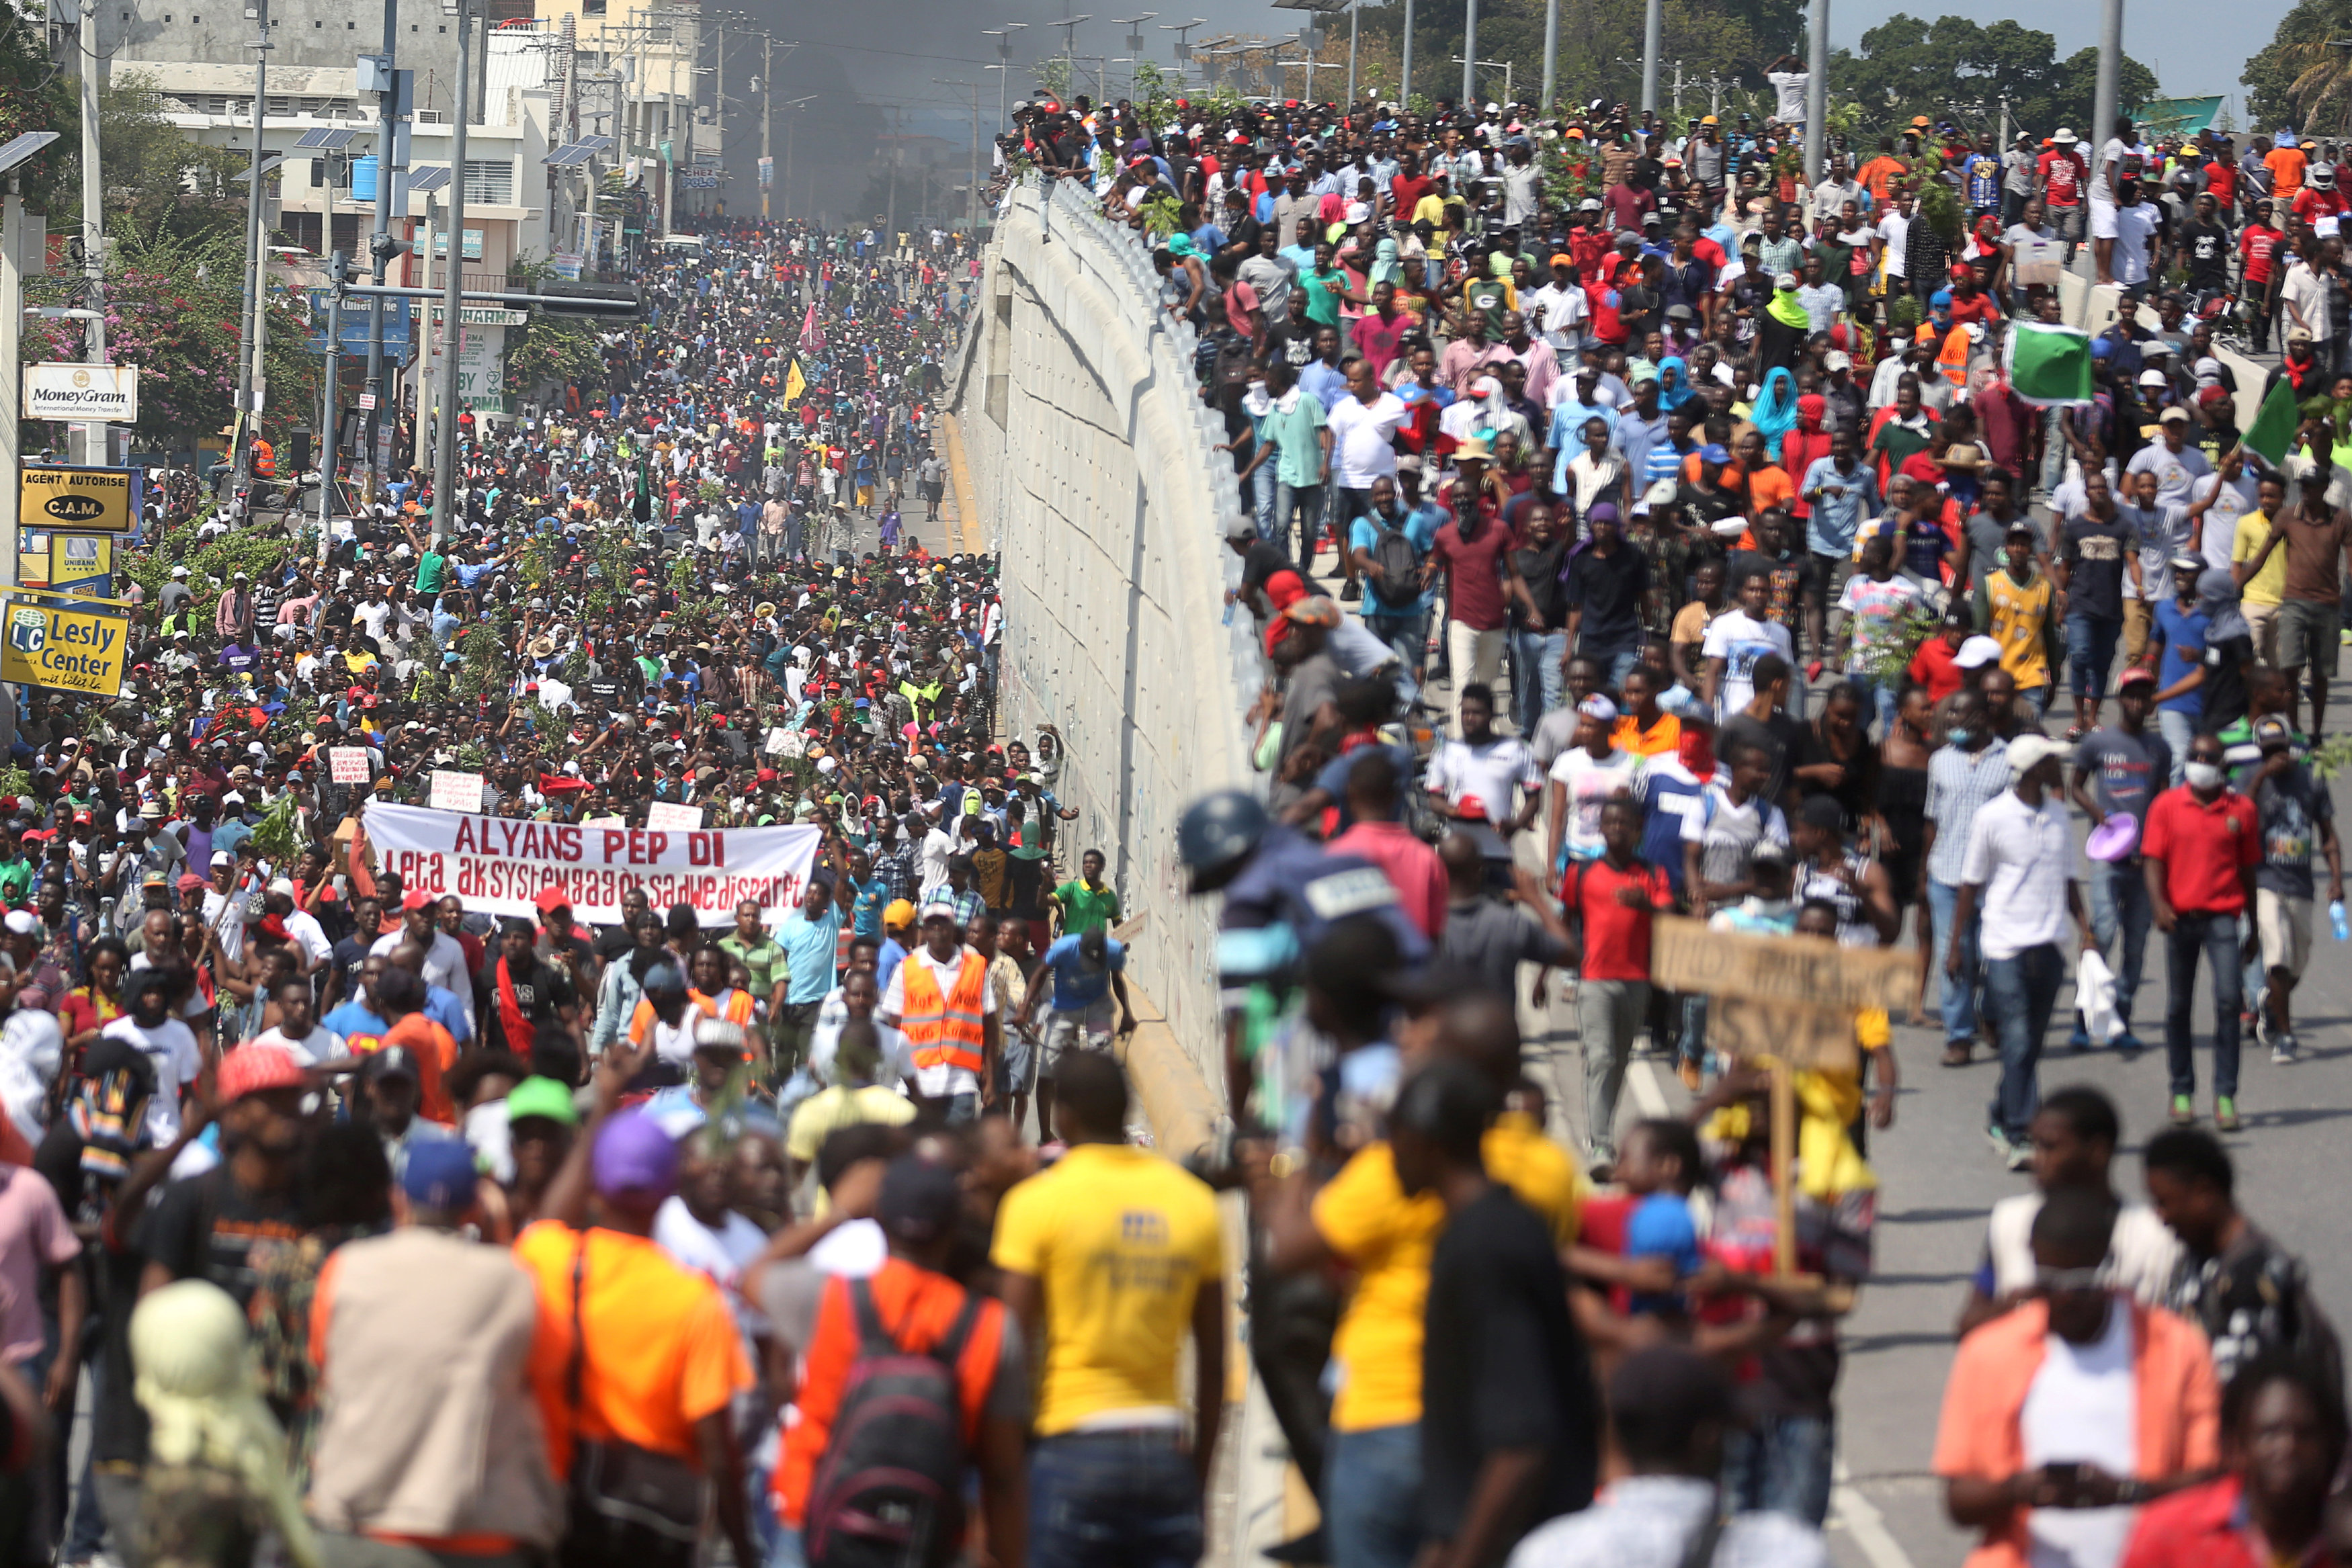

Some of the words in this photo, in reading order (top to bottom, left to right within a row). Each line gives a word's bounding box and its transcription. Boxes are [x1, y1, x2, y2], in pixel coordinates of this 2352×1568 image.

[26, 474, 62, 484] AGENT
[69, 476, 126, 487] AUTORISE
[48, 500, 99, 515] C.A.M.
[73, 585, 93, 594] TOUT
[50, 614, 116, 654] Lesly
[42, 648, 112, 677] Center
[40, 674, 58, 684] mèt
[61, 673, 86, 687] bòlèt
[89, 677, 101, 689] la
[454, 816, 583, 862] ALYANS
[688, 831, 724, 867] DI
